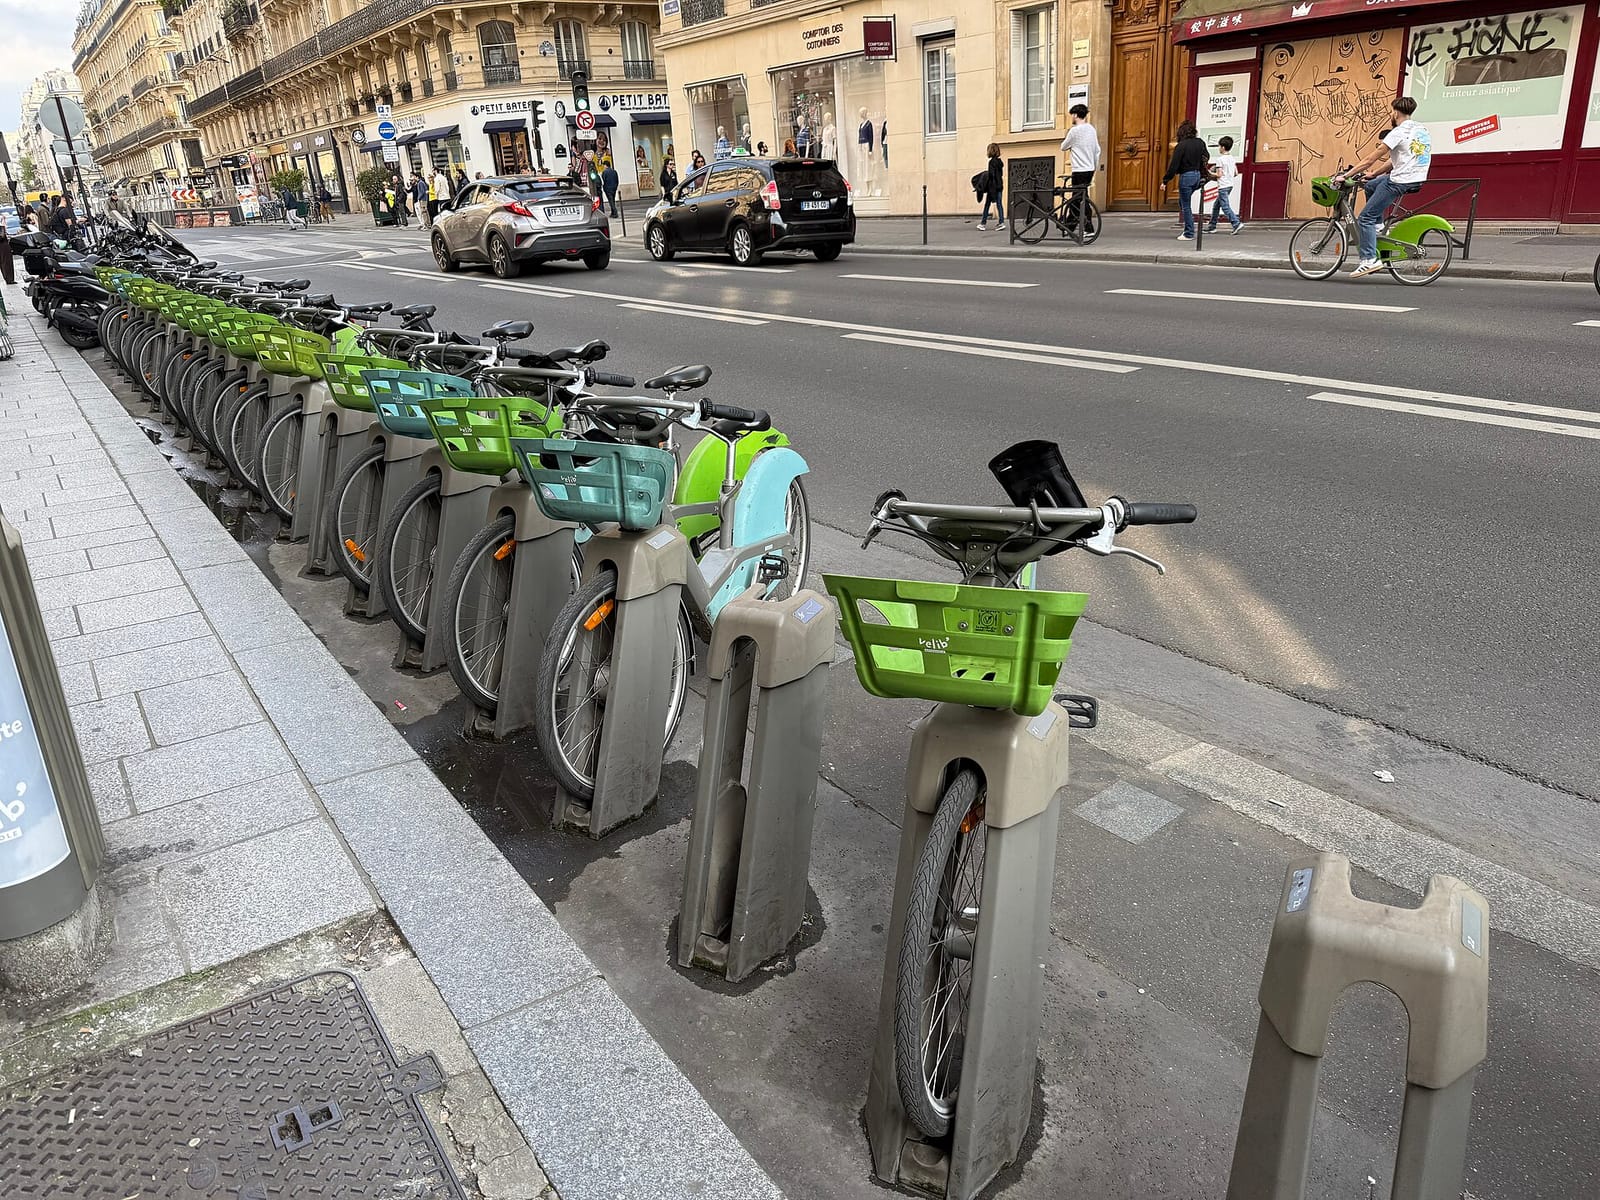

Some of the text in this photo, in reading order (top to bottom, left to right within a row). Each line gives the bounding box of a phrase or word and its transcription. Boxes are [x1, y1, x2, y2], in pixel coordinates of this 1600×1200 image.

[802, 23, 843, 39] COMPTOIR DES
[807, 36, 840, 50] COTONNIERS
[1442, 84, 1520, 98] traiteur asiatique
[612, 94, 643, 107] PETIT
[1209, 96, 1237, 104] Horeca
[480, 103, 503, 112] PETIT
[1212, 103, 1232, 111] Paris
[0, 719, 23, 739] te
